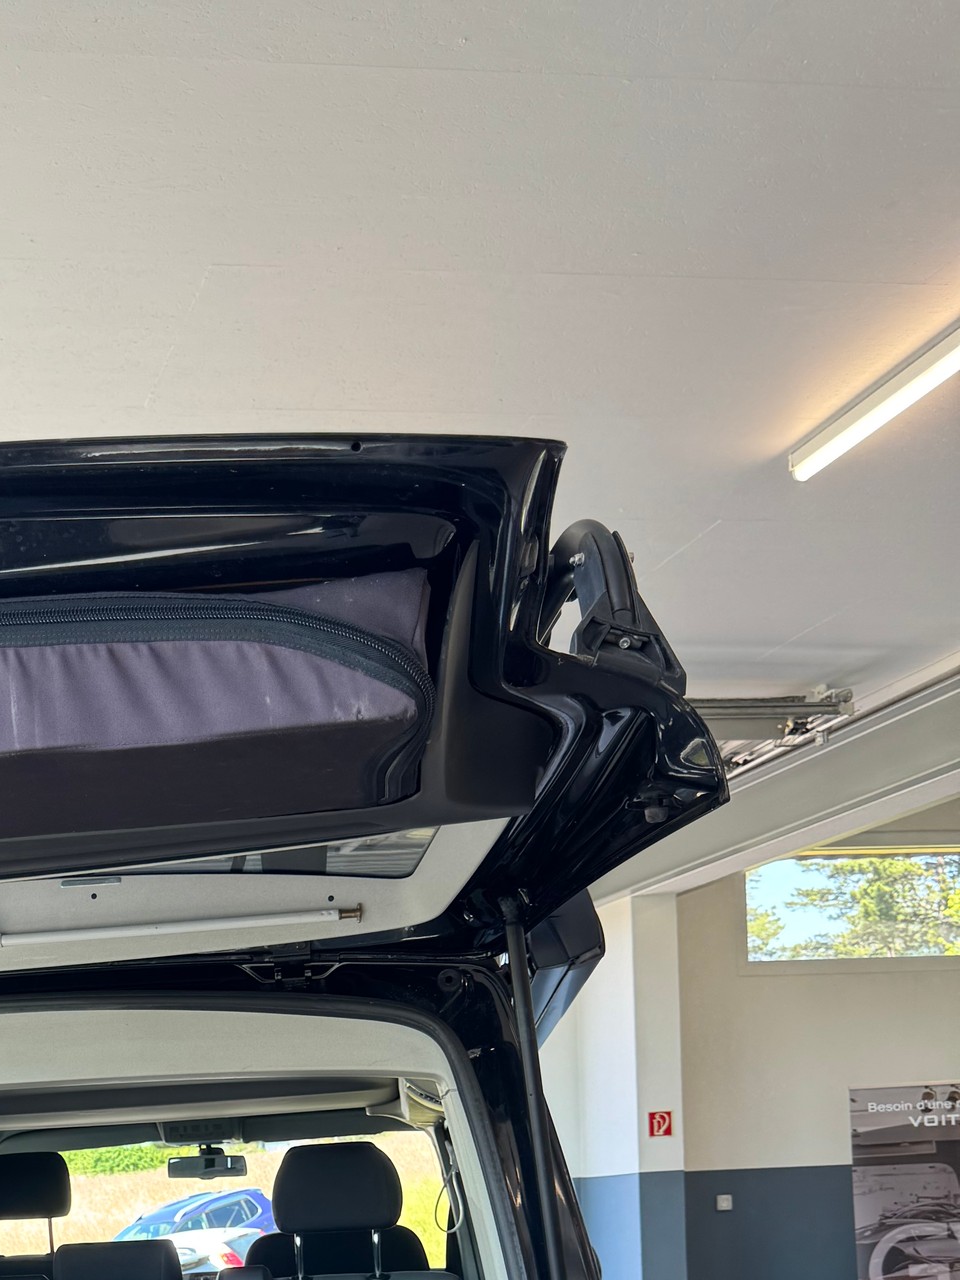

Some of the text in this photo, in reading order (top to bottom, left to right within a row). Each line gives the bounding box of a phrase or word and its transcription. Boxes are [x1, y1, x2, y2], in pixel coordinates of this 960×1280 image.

[867, 1100, 913, 1113] Besoin
[916, 1099, 952, 1110] d'une
[908, 1114, 960, 1127] VOIT
